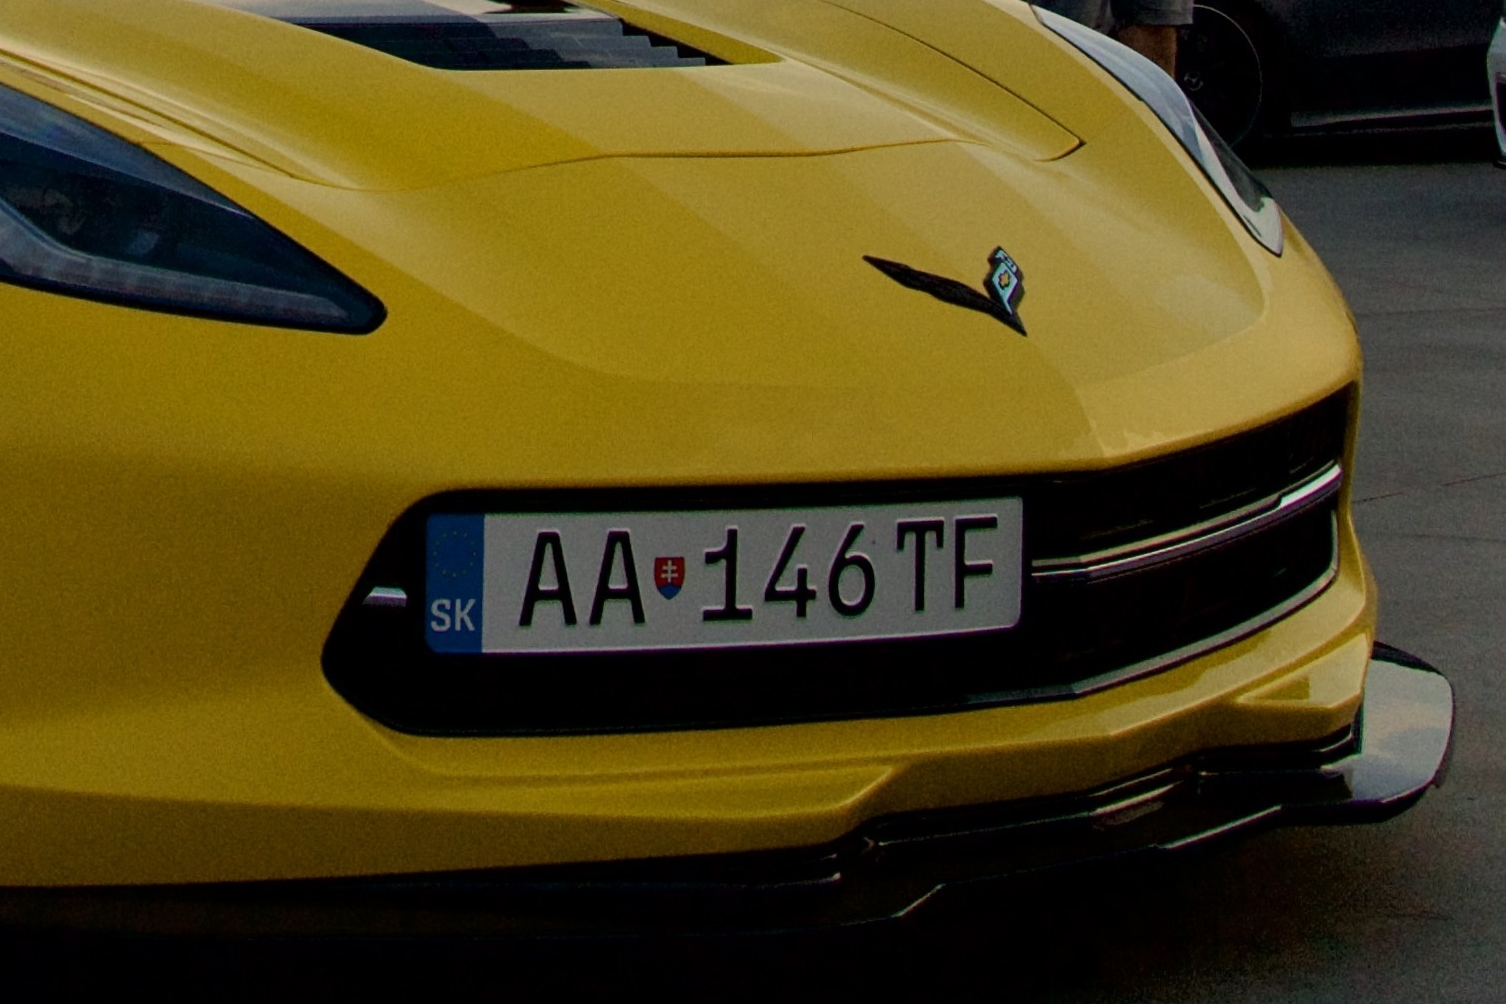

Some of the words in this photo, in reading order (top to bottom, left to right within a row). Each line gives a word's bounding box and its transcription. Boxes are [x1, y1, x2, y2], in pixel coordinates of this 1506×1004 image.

[519, 530, 646, 627] AA
[702, 515, 998, 622] 146TF
[430, 598, 476, 633] SK
